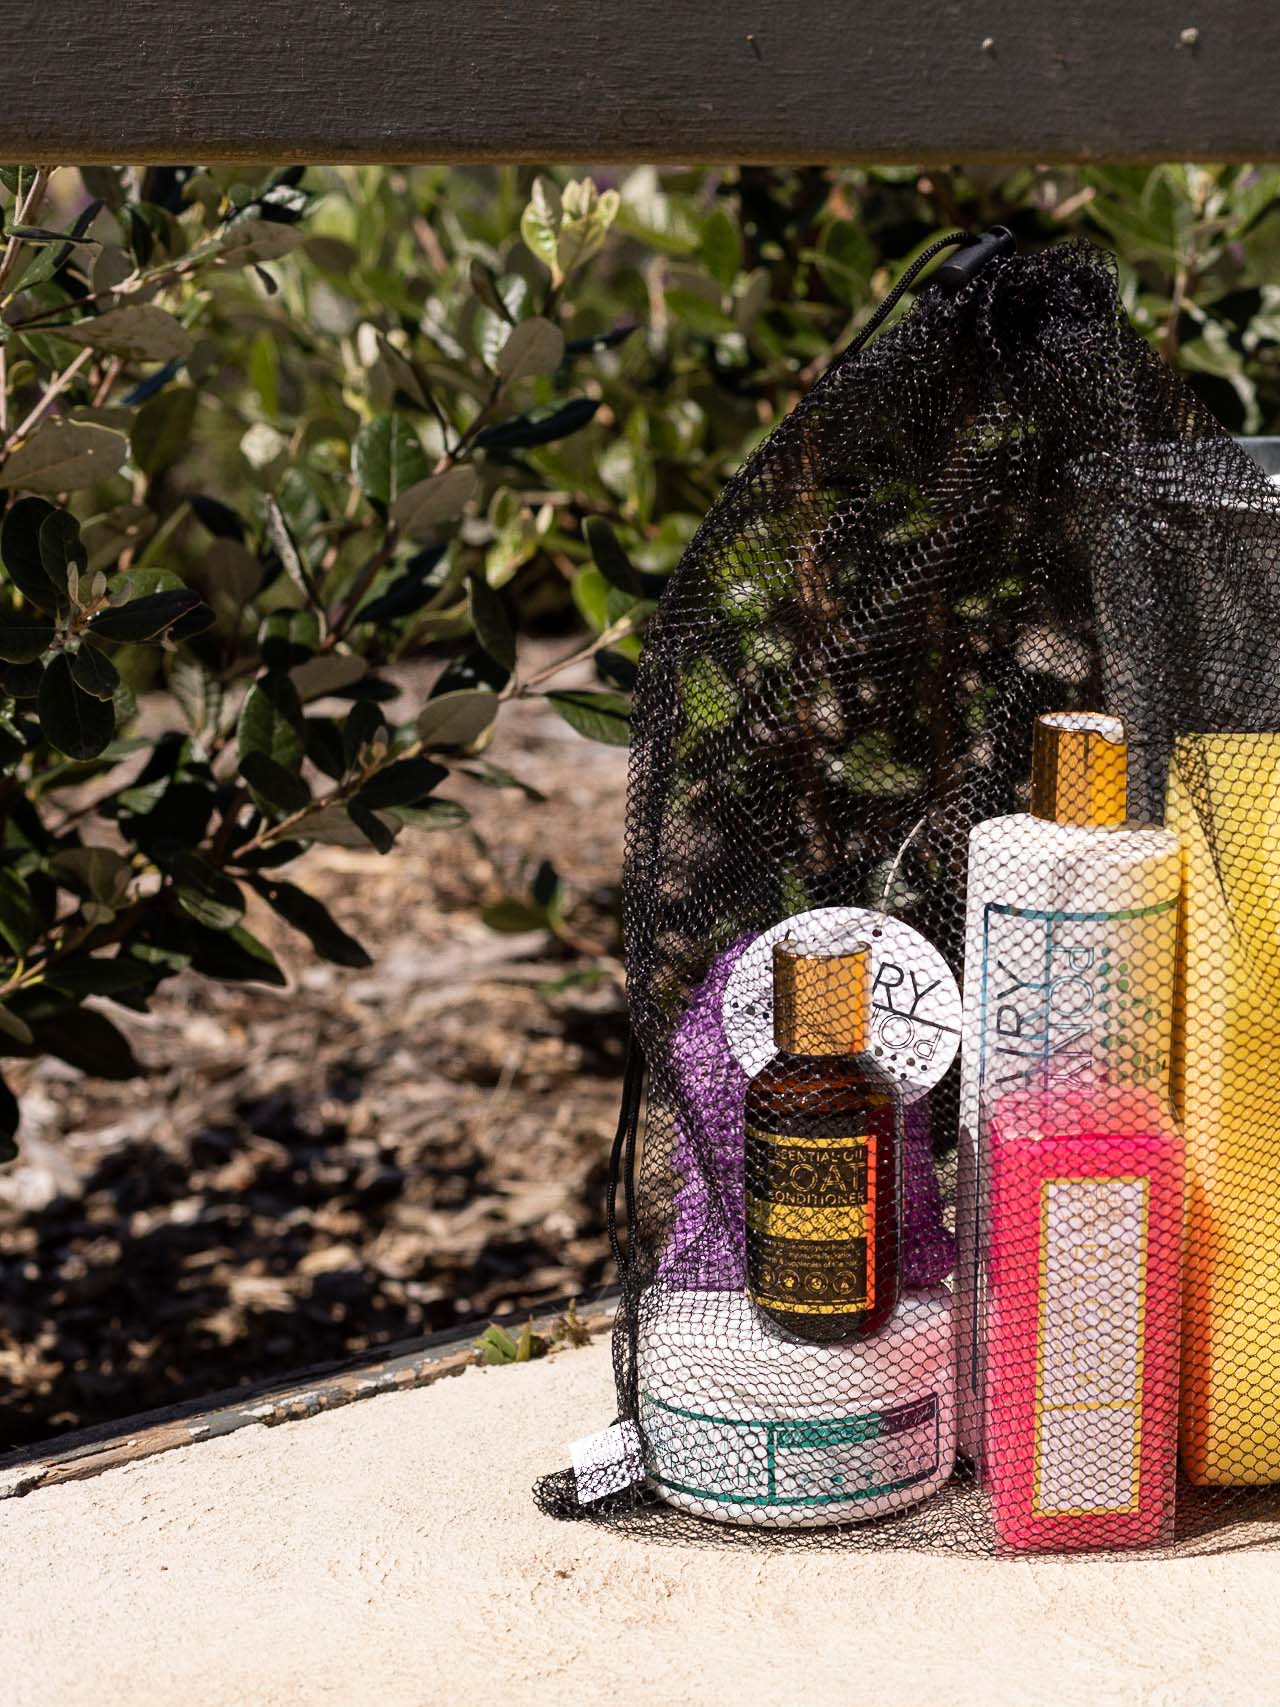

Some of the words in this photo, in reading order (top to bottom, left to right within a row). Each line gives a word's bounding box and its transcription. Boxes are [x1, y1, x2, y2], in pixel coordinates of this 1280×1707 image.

[873, 1008, 943, 1061] PO
[995, 959, 1048, 1088] AIRY
[1048, 945, 1095, 1091] PONY
[767, 1160, 866, 1193] COAT
[767, 1190, 866, 1205] CONDITIONER
